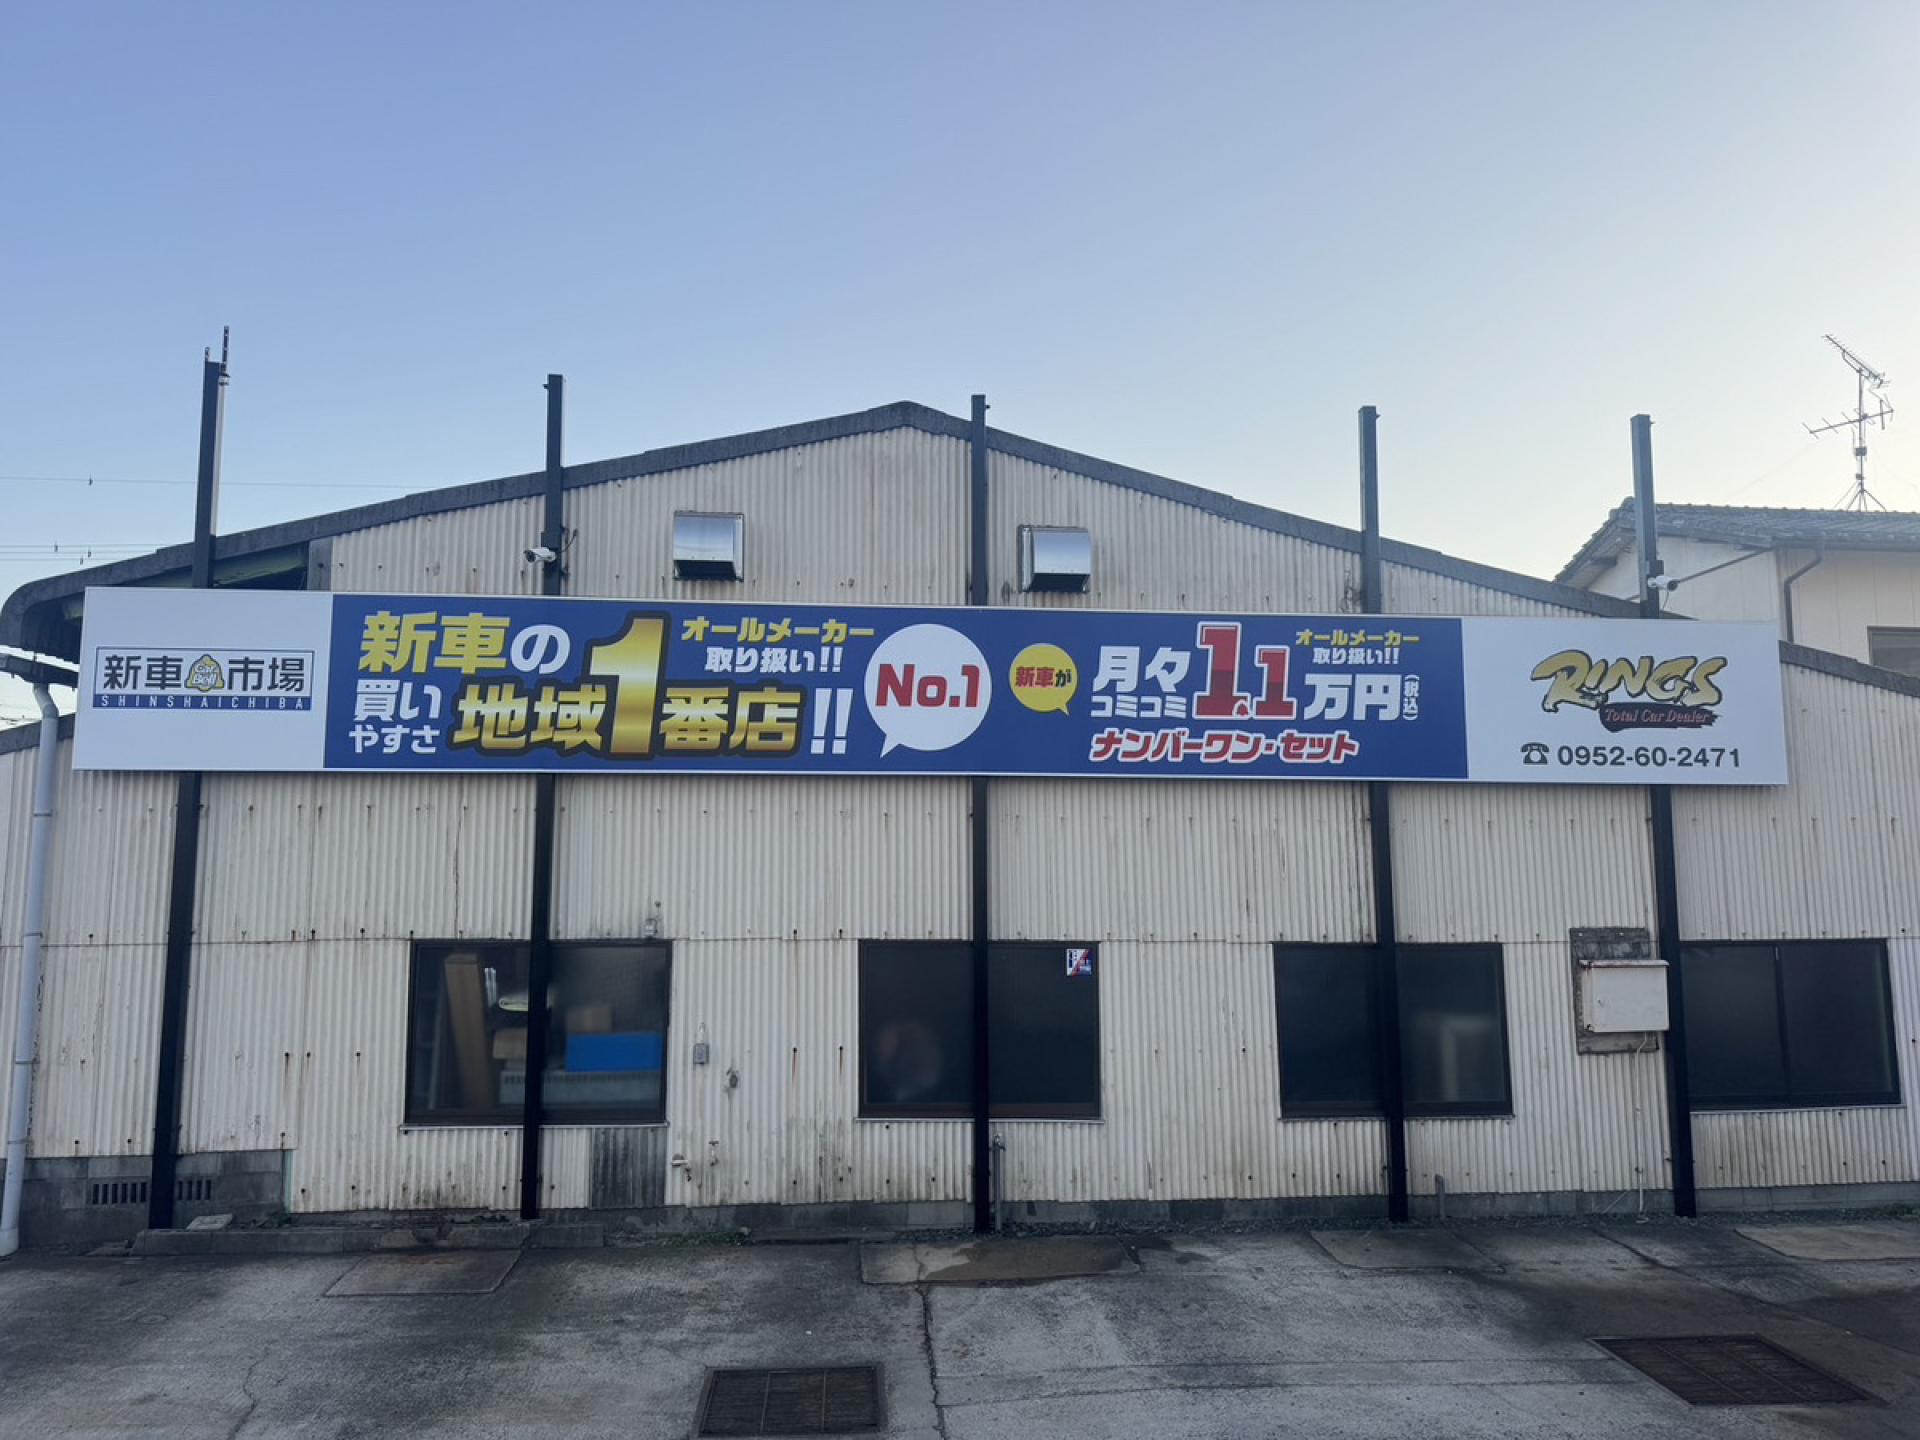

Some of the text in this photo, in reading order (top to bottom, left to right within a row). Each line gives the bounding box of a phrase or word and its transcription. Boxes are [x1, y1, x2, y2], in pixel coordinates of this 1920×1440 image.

[358, 610, 571, 674] 新車の
[681, 616, 875, 643] オールメーカー
[1295, 628, 1420, 646] オールメーカー
[704, 646, 843, 673] 取り扱い!!
[1312, 647, 1399, 665] 取り扱い!!
[103, 654, 305, 692] 新車市場
[875, 663, 980, 708] No.1
[1015, 666, 1072, 689] 新車が
[1531, 649, 1727, 712] RINGS
[101, 695, 304, 710] SHINSHAICHIBA
[353, 679, 442, 722] 買い
[1090, 694, 1187, 719] コミコミ
[1605, 708, 1711, 723] Total Car Dealer
[348, 725, 440, 753] やすさ
[1557, 746, 1739, 767] 0952-60-2471
